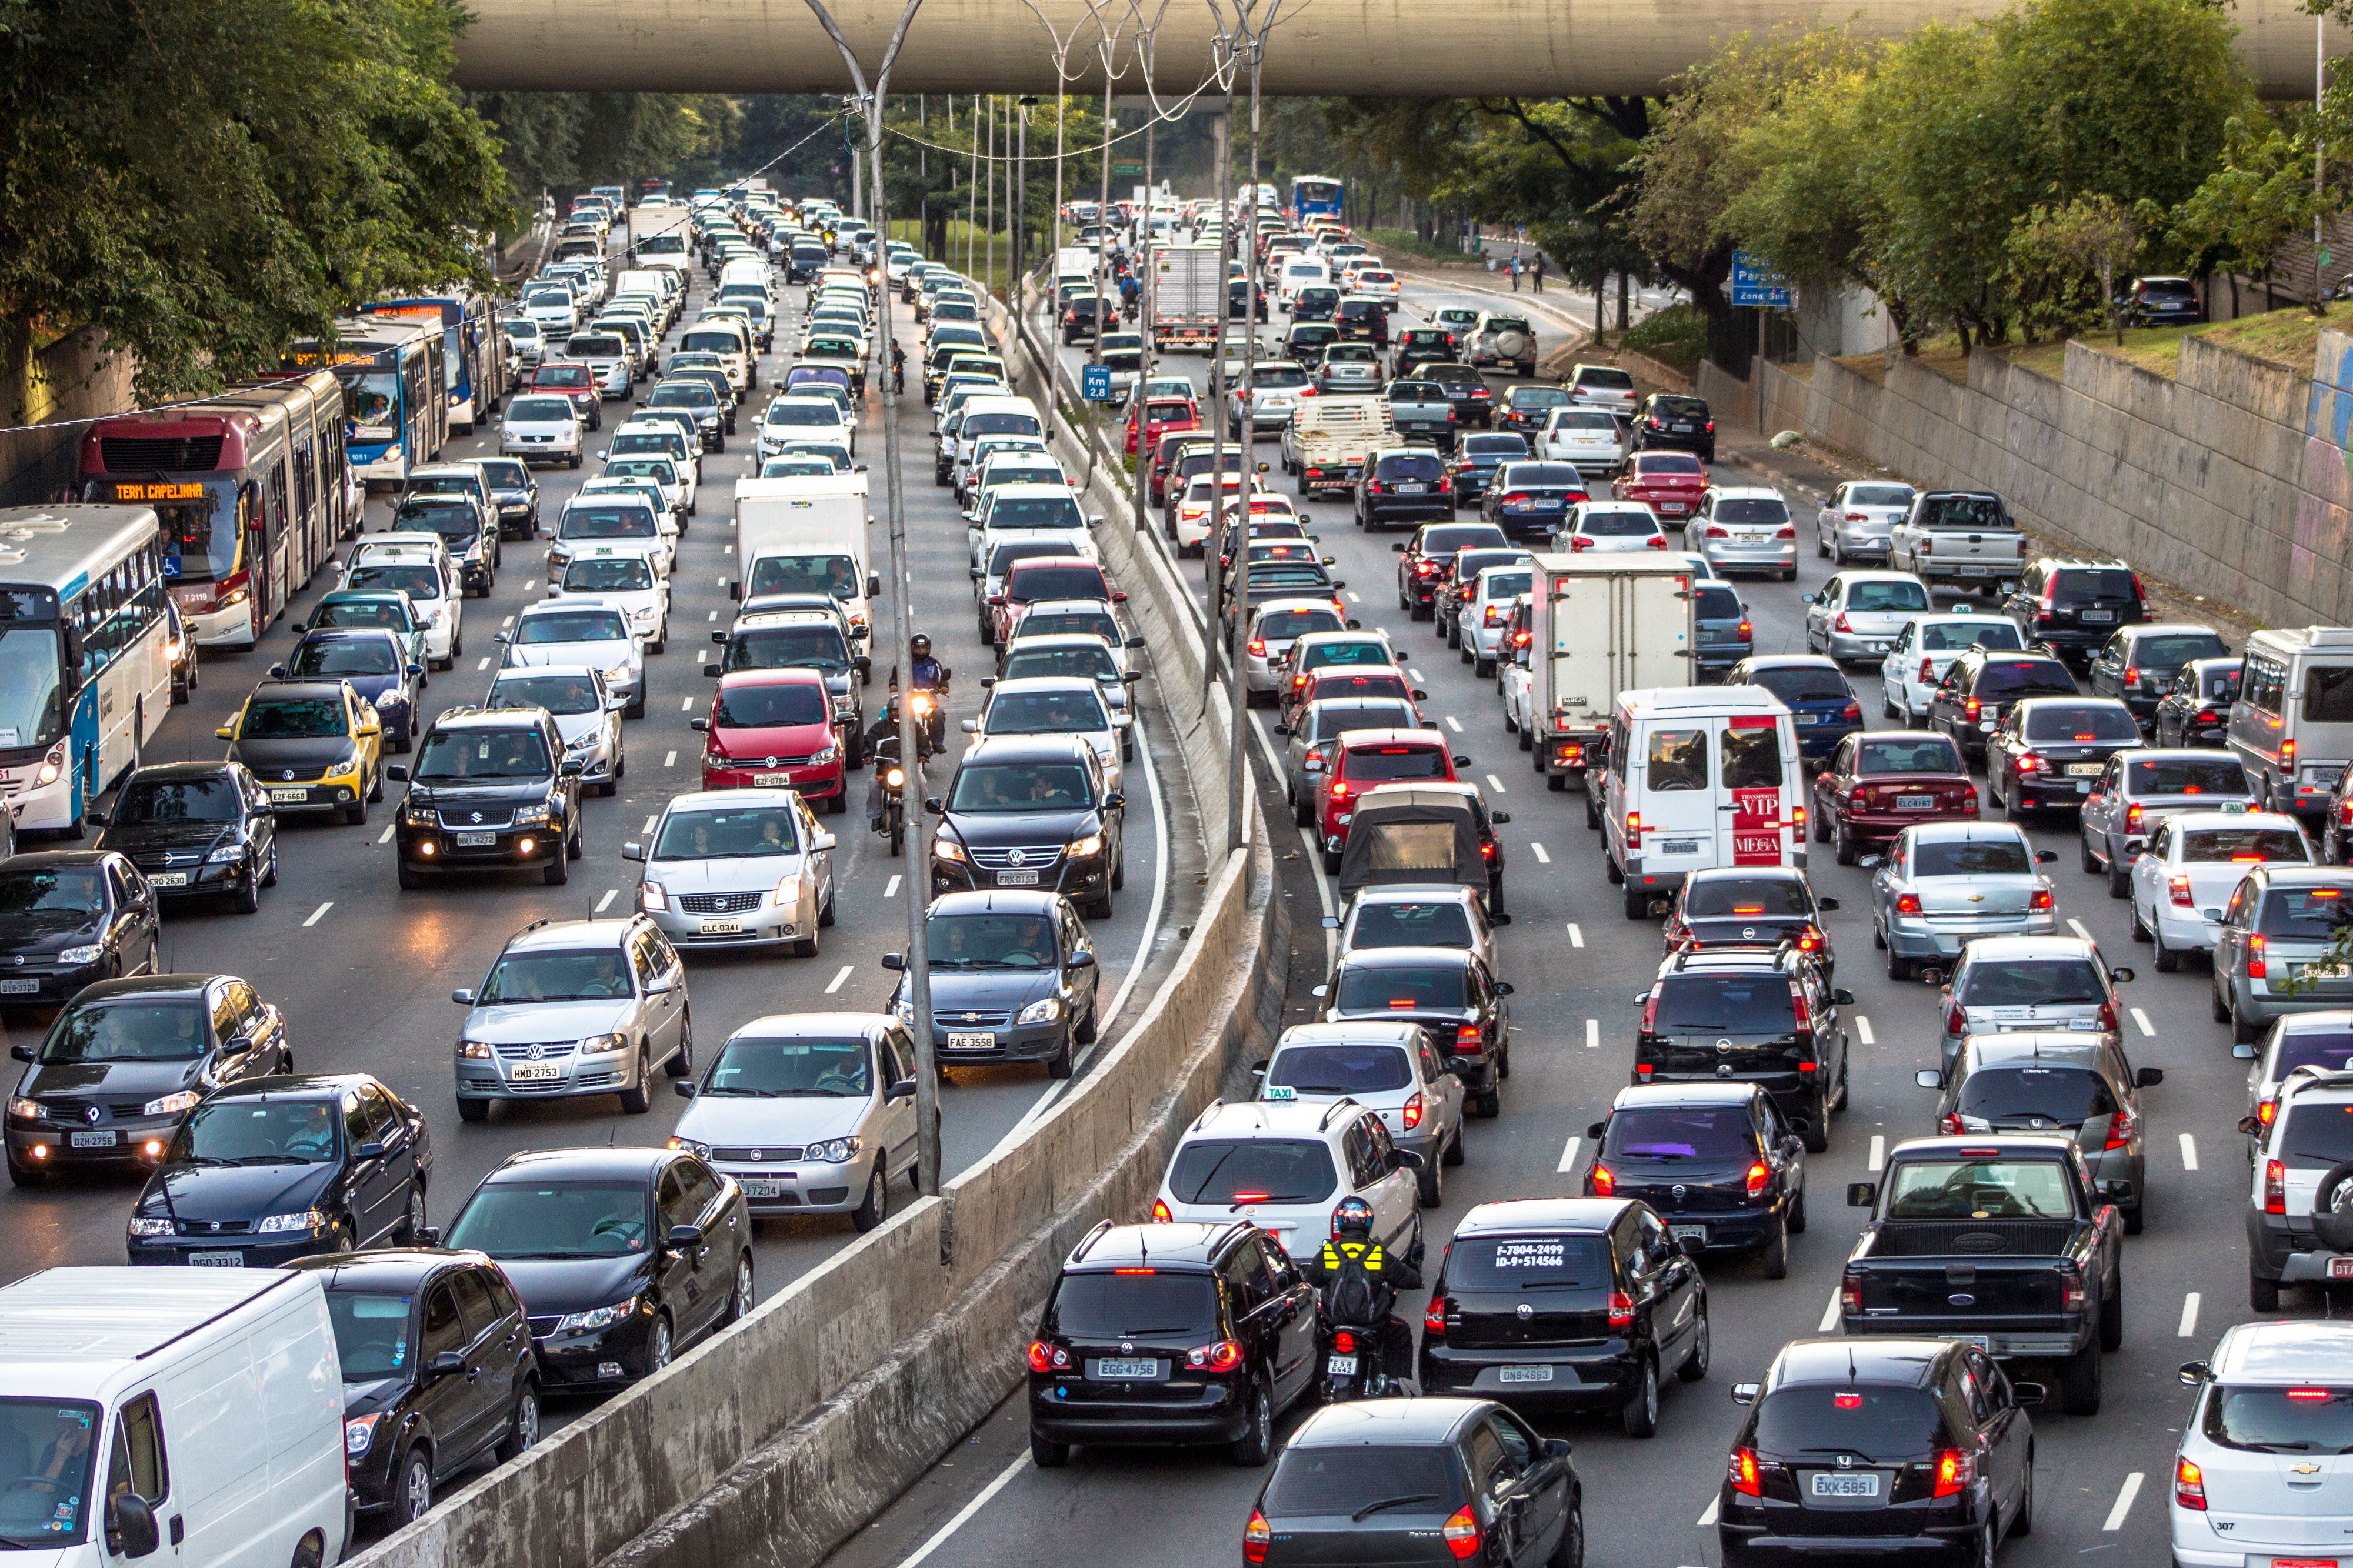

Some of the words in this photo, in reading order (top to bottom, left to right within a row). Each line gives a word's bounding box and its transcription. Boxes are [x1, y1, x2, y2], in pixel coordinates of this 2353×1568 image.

[1089, 377, 1105, 386] Km
[1090, 388, 1105, 398] 2,8
[117, 485, 145, 499] TERM.
[148, 483, 203, 499] CAPELINHA
[191, 593, 208, 602] 2119
[1741, 799, 1778, 816] VIP
[2225, 803, 2242, 812] TAXI
[1735, 837, 1779, 852] MEGA
[1268, 1089, 1291, 1099] TAXI
[1496, 1245, 1564, 1256] F-7804-2499
[2216, 1522, 2235, 1530] 307
